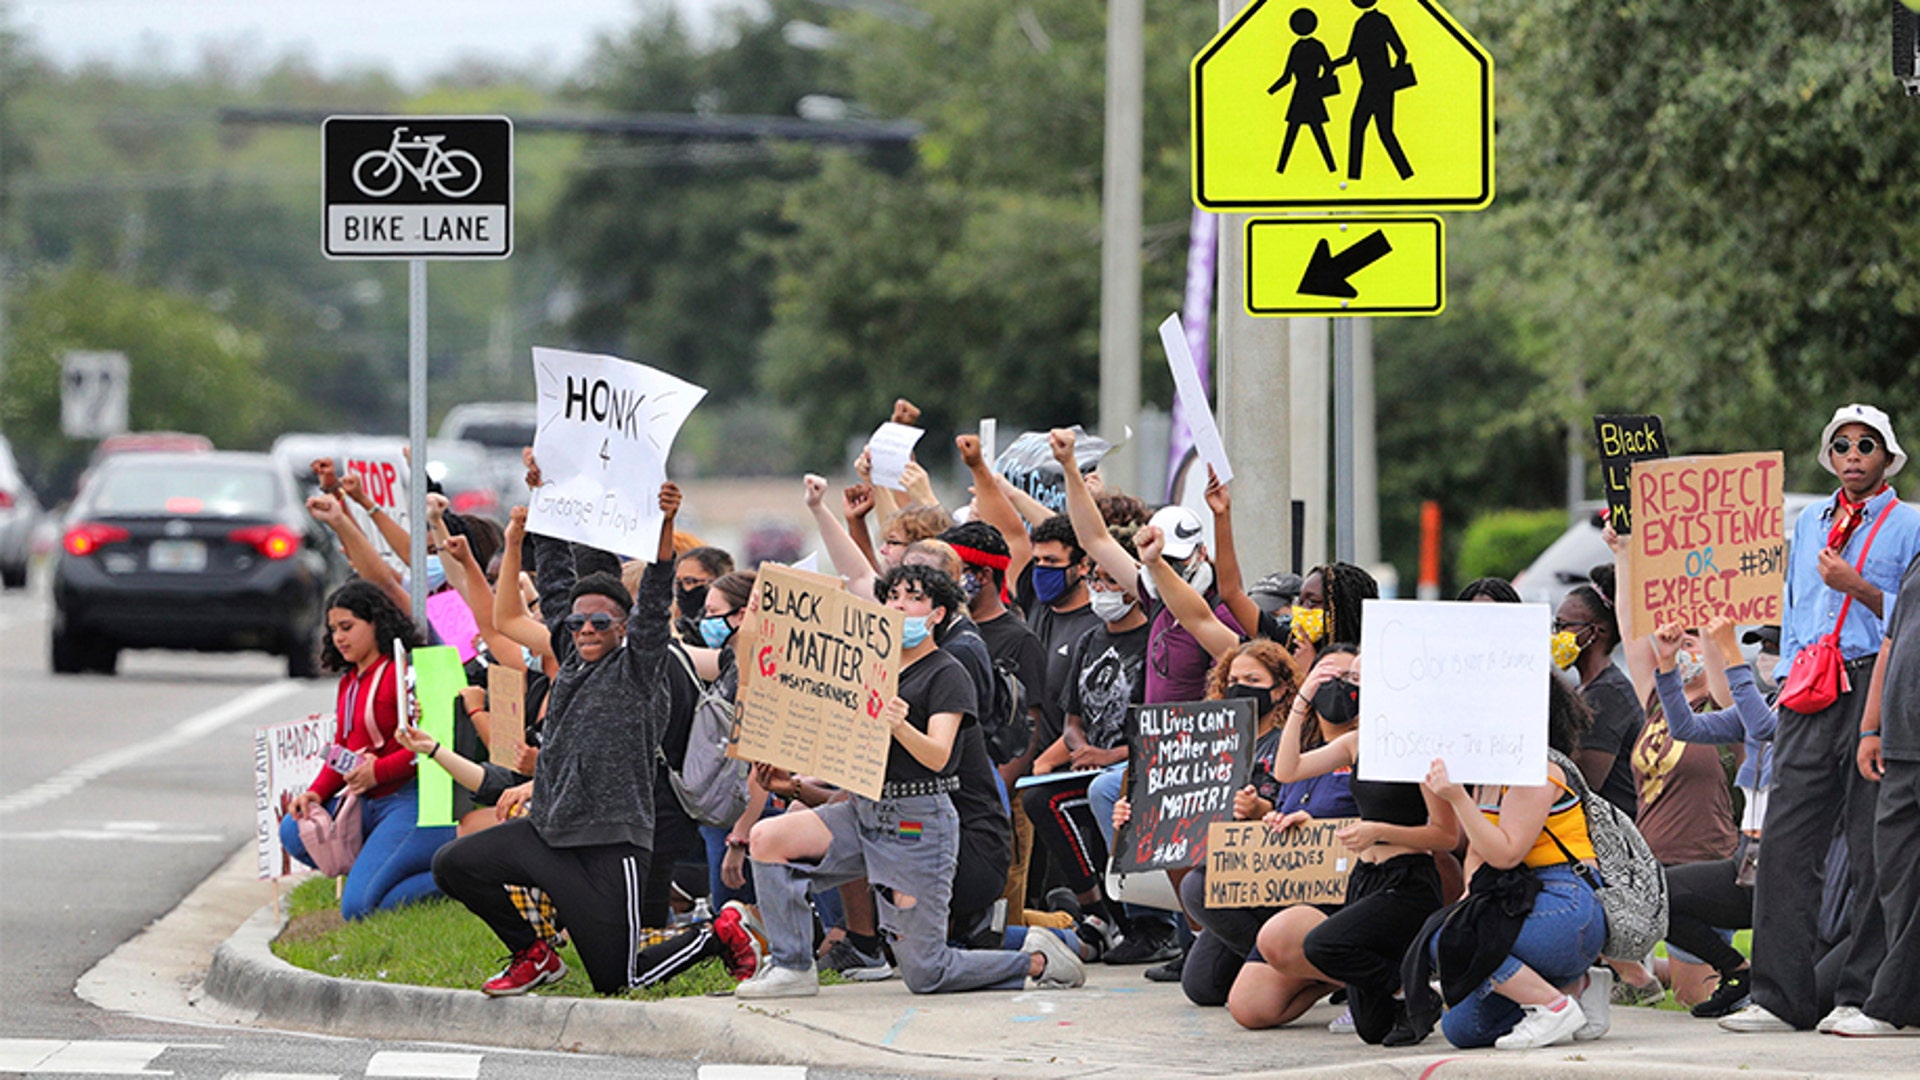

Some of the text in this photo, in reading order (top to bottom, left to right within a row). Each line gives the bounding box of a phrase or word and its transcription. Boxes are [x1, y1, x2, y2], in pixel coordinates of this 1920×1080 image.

[344, 216, 490, 241] BIKE LANE
[565, 375, 646, 440] HONK
[598, 437, 611, 470] 4
[1600, 422, 1659, 457] Black
[1638, 459, 1777, 517] RESPECT
[535, 479, 640, 537] George Floyd
[1642, 506, 1781, 556] EXISTENCE
[1684, 546, 1720, 577] OR
[1643, 568, 1740, 611] EXPECT
[761, 581, 892, 660] BLACK LIVES
[786, 627, 863, 684] MATTER
[1139, 708, 1237, 736] ALL Lives CAN'T
[275, 721, 320, 760] HANDS
[1158, 733, 1240, 764] Matter until
[1148, 761, 1233, 795] BLACK Lives
[1159, 786, 1232, 821] MATTER!
[1224, 826, 1253, 847] IF
[1212, 850, 1249, 873] THINK
[1210, 880, 1260, 904] MATTER
